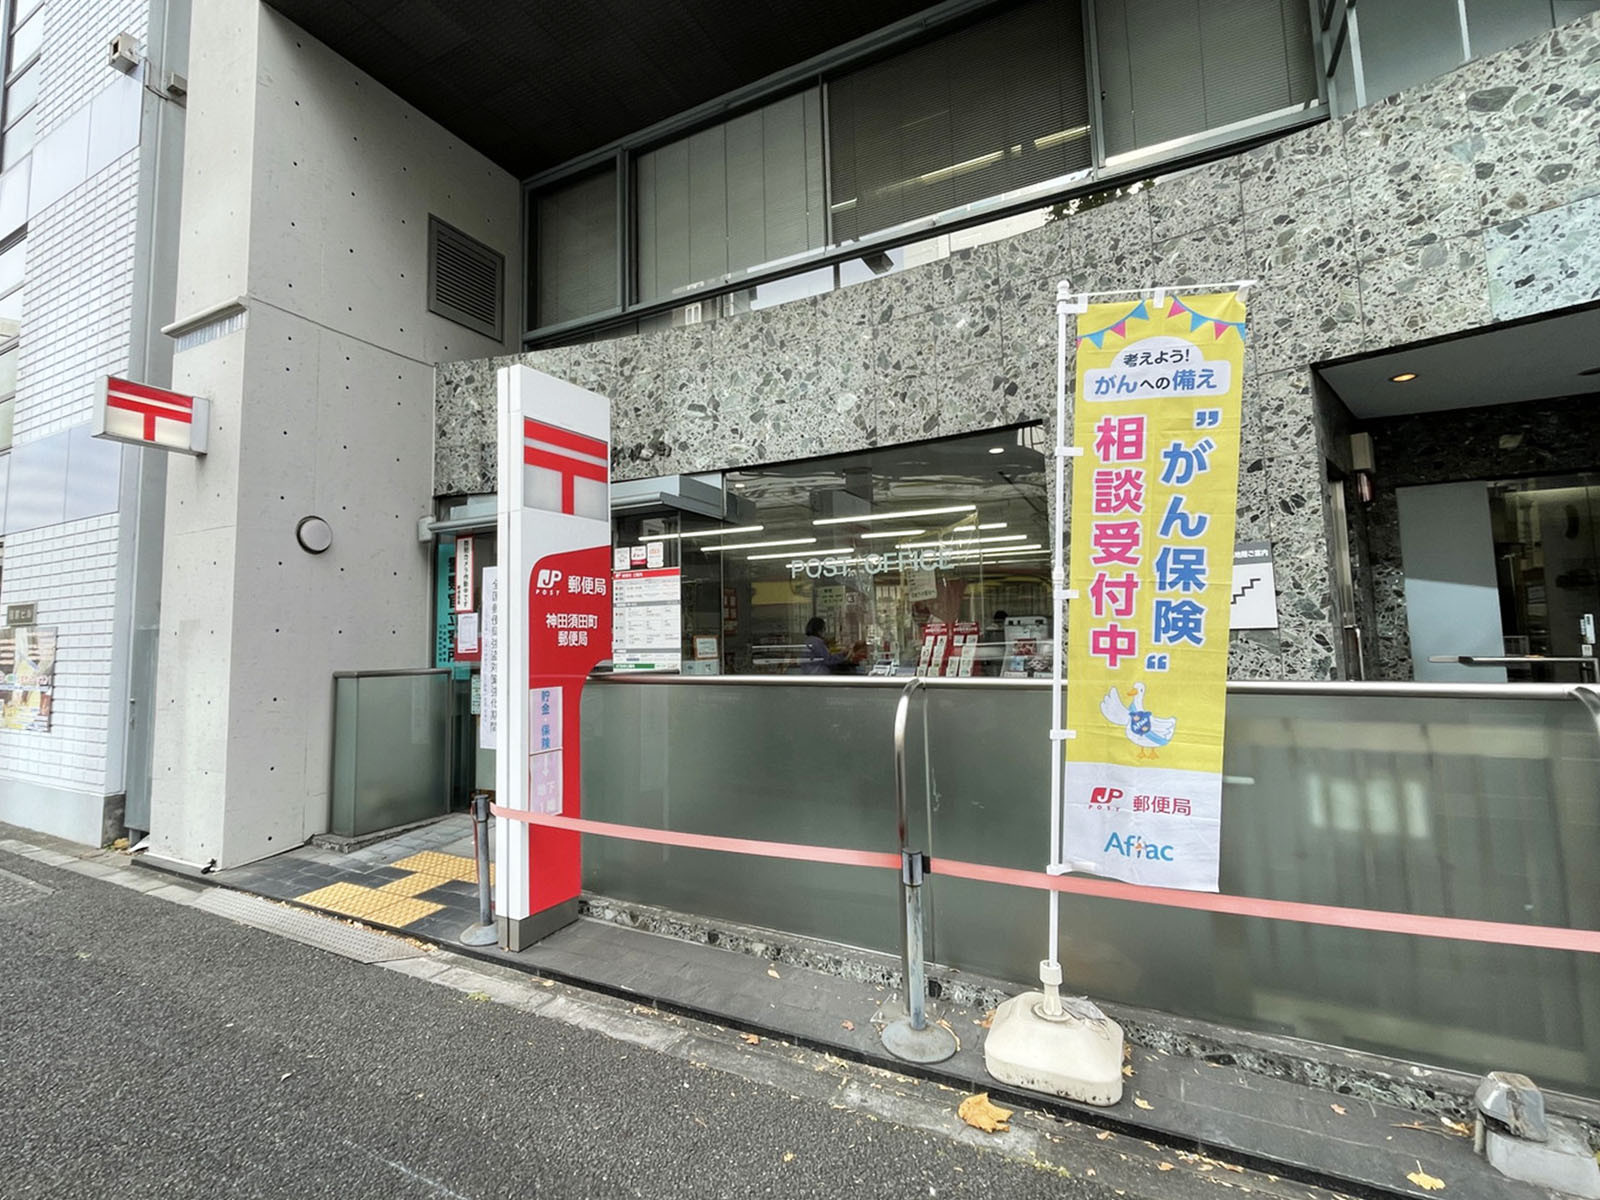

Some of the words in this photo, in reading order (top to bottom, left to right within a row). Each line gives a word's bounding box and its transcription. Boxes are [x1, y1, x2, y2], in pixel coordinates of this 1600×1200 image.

[1123, 348, 1190, 368] 考えよう!
[1094, 368, 1218, 396] がんへの備え
[1090, 416, 1146, 668] 相談受付中
[791, 555, 852, 580] POST
[863, 548, 955, 576] OFFICE
[567, 575, 607, 596] 郵便局
[546, 613, 599, 629] 神田須田町
[557, 630, 589, 647] 郵便局
[1088, 804, 1121, 812] POST
[1132, 795, 1192, 816] 郵便局
